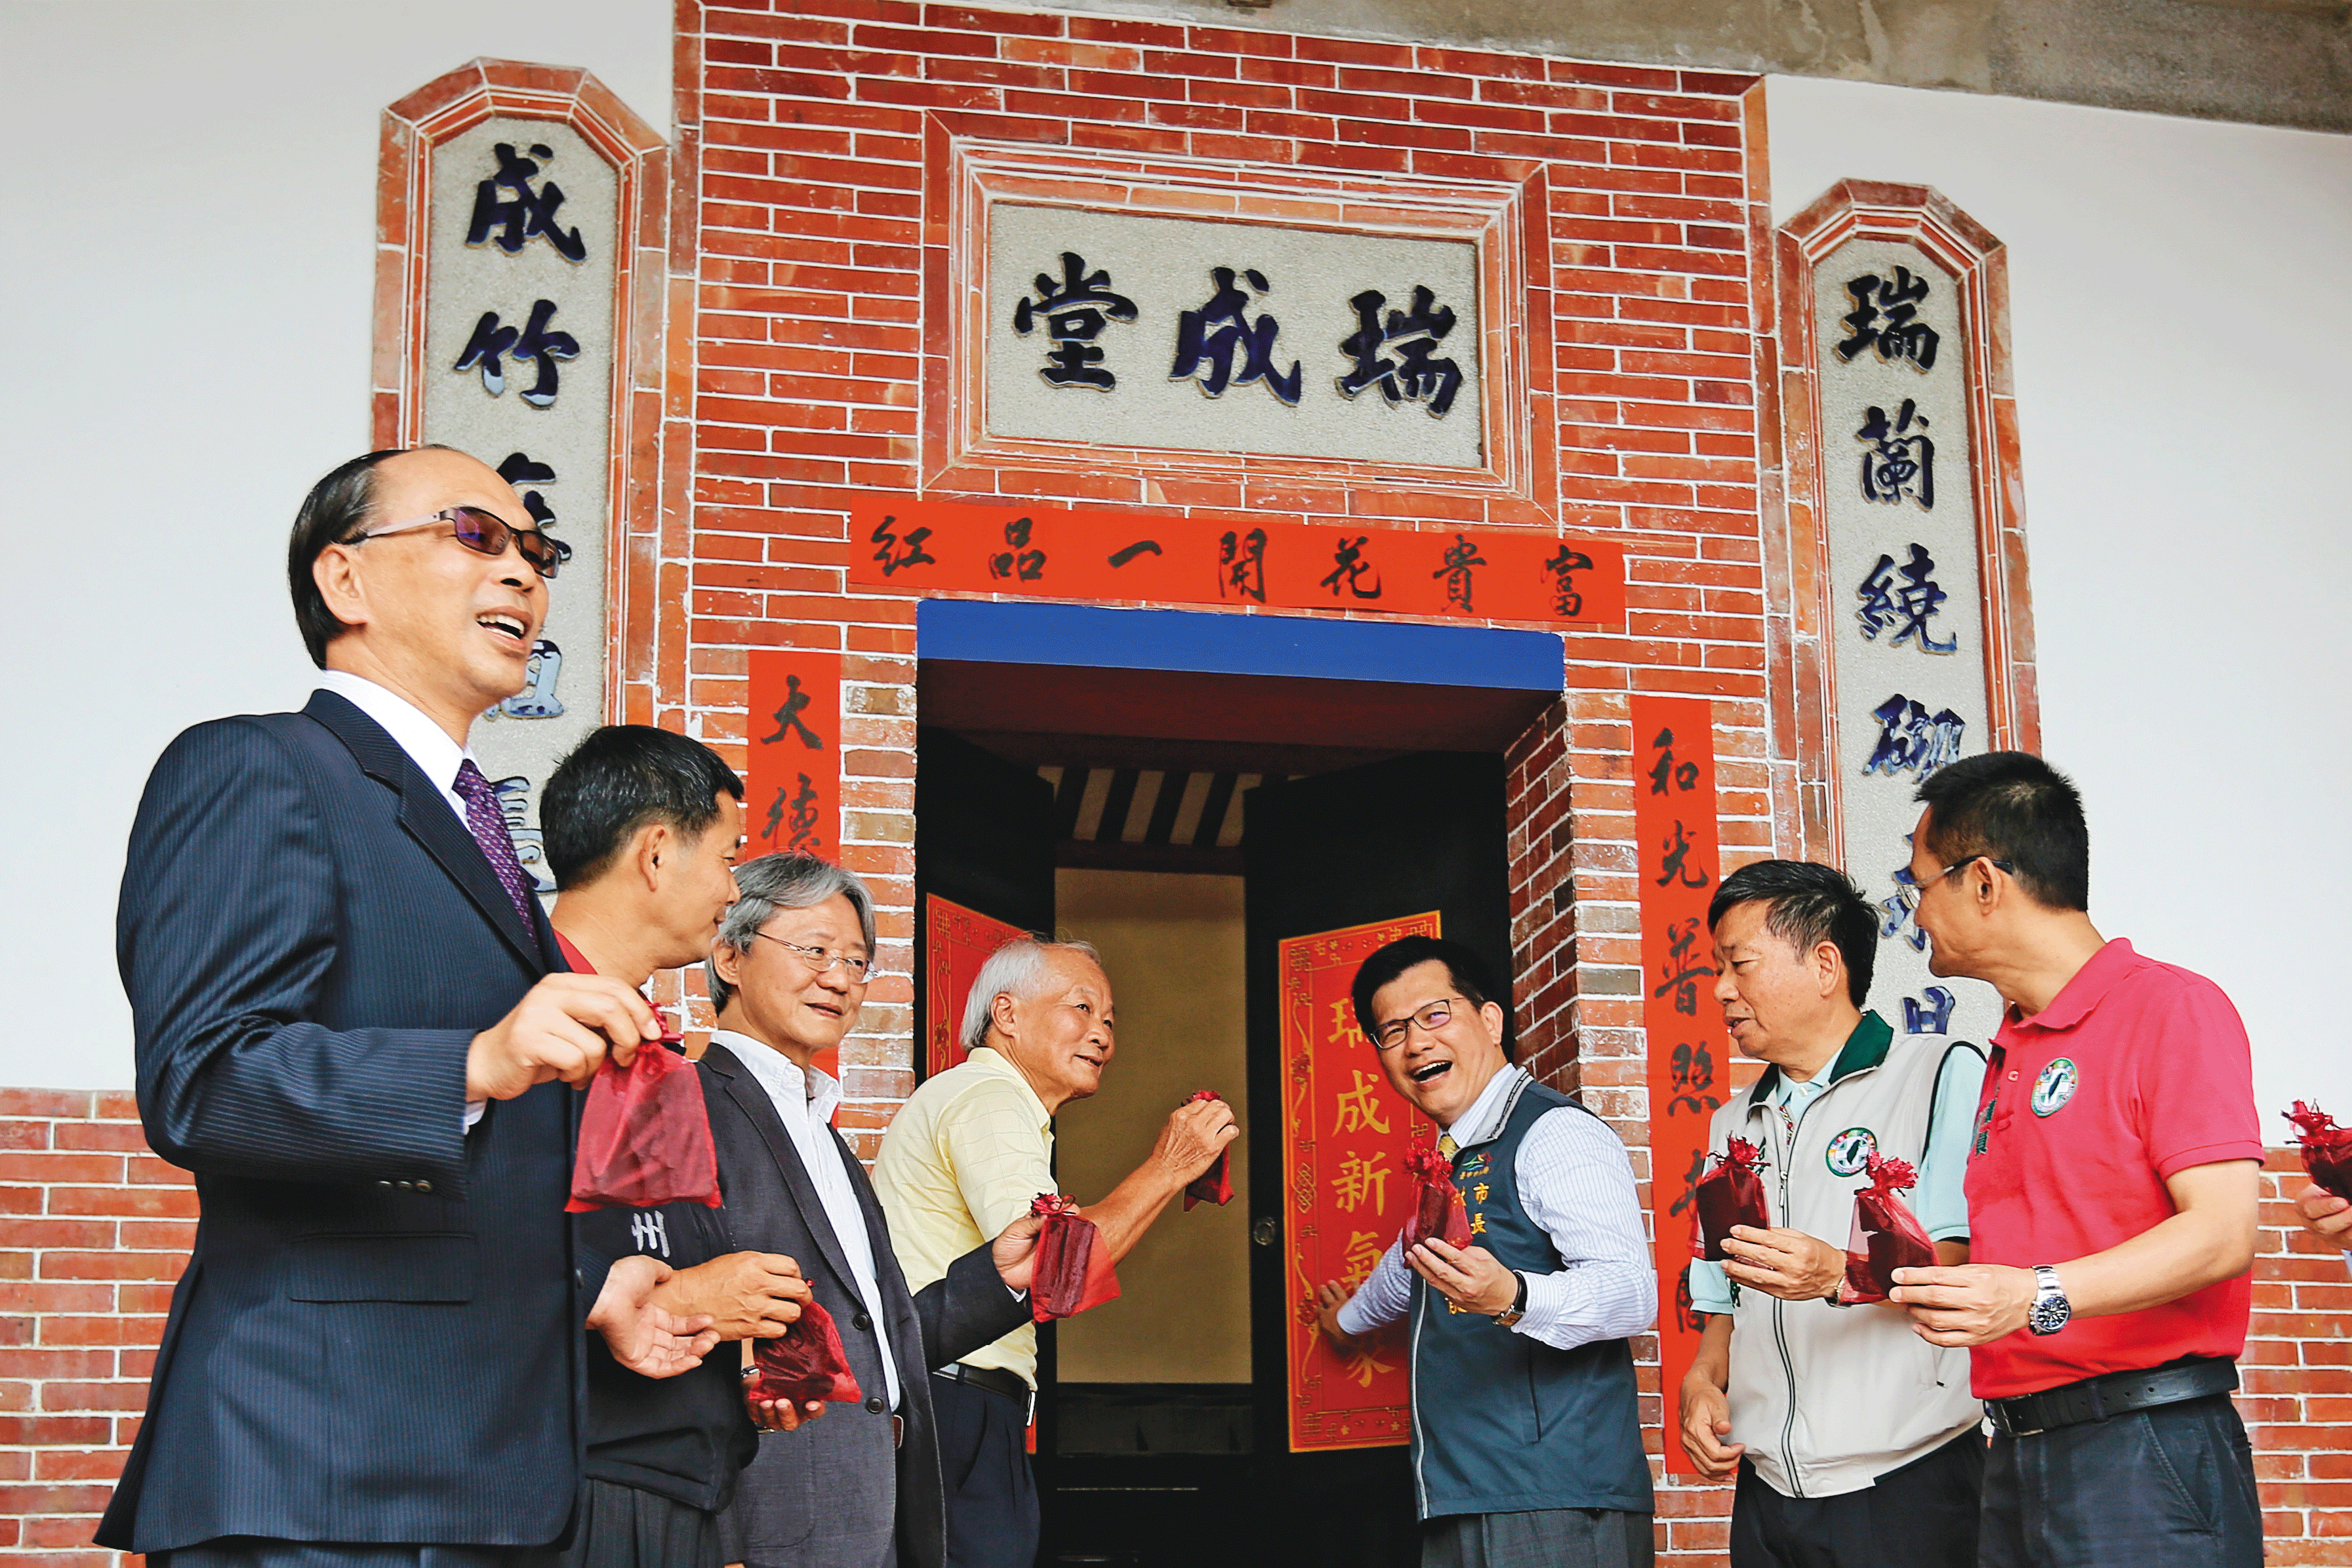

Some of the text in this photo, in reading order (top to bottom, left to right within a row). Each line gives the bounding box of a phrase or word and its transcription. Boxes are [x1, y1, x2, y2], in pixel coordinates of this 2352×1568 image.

[1013, 251, 1463, 419] 瑞成堂
[1470, 1182, 1490, 1235] 市長
